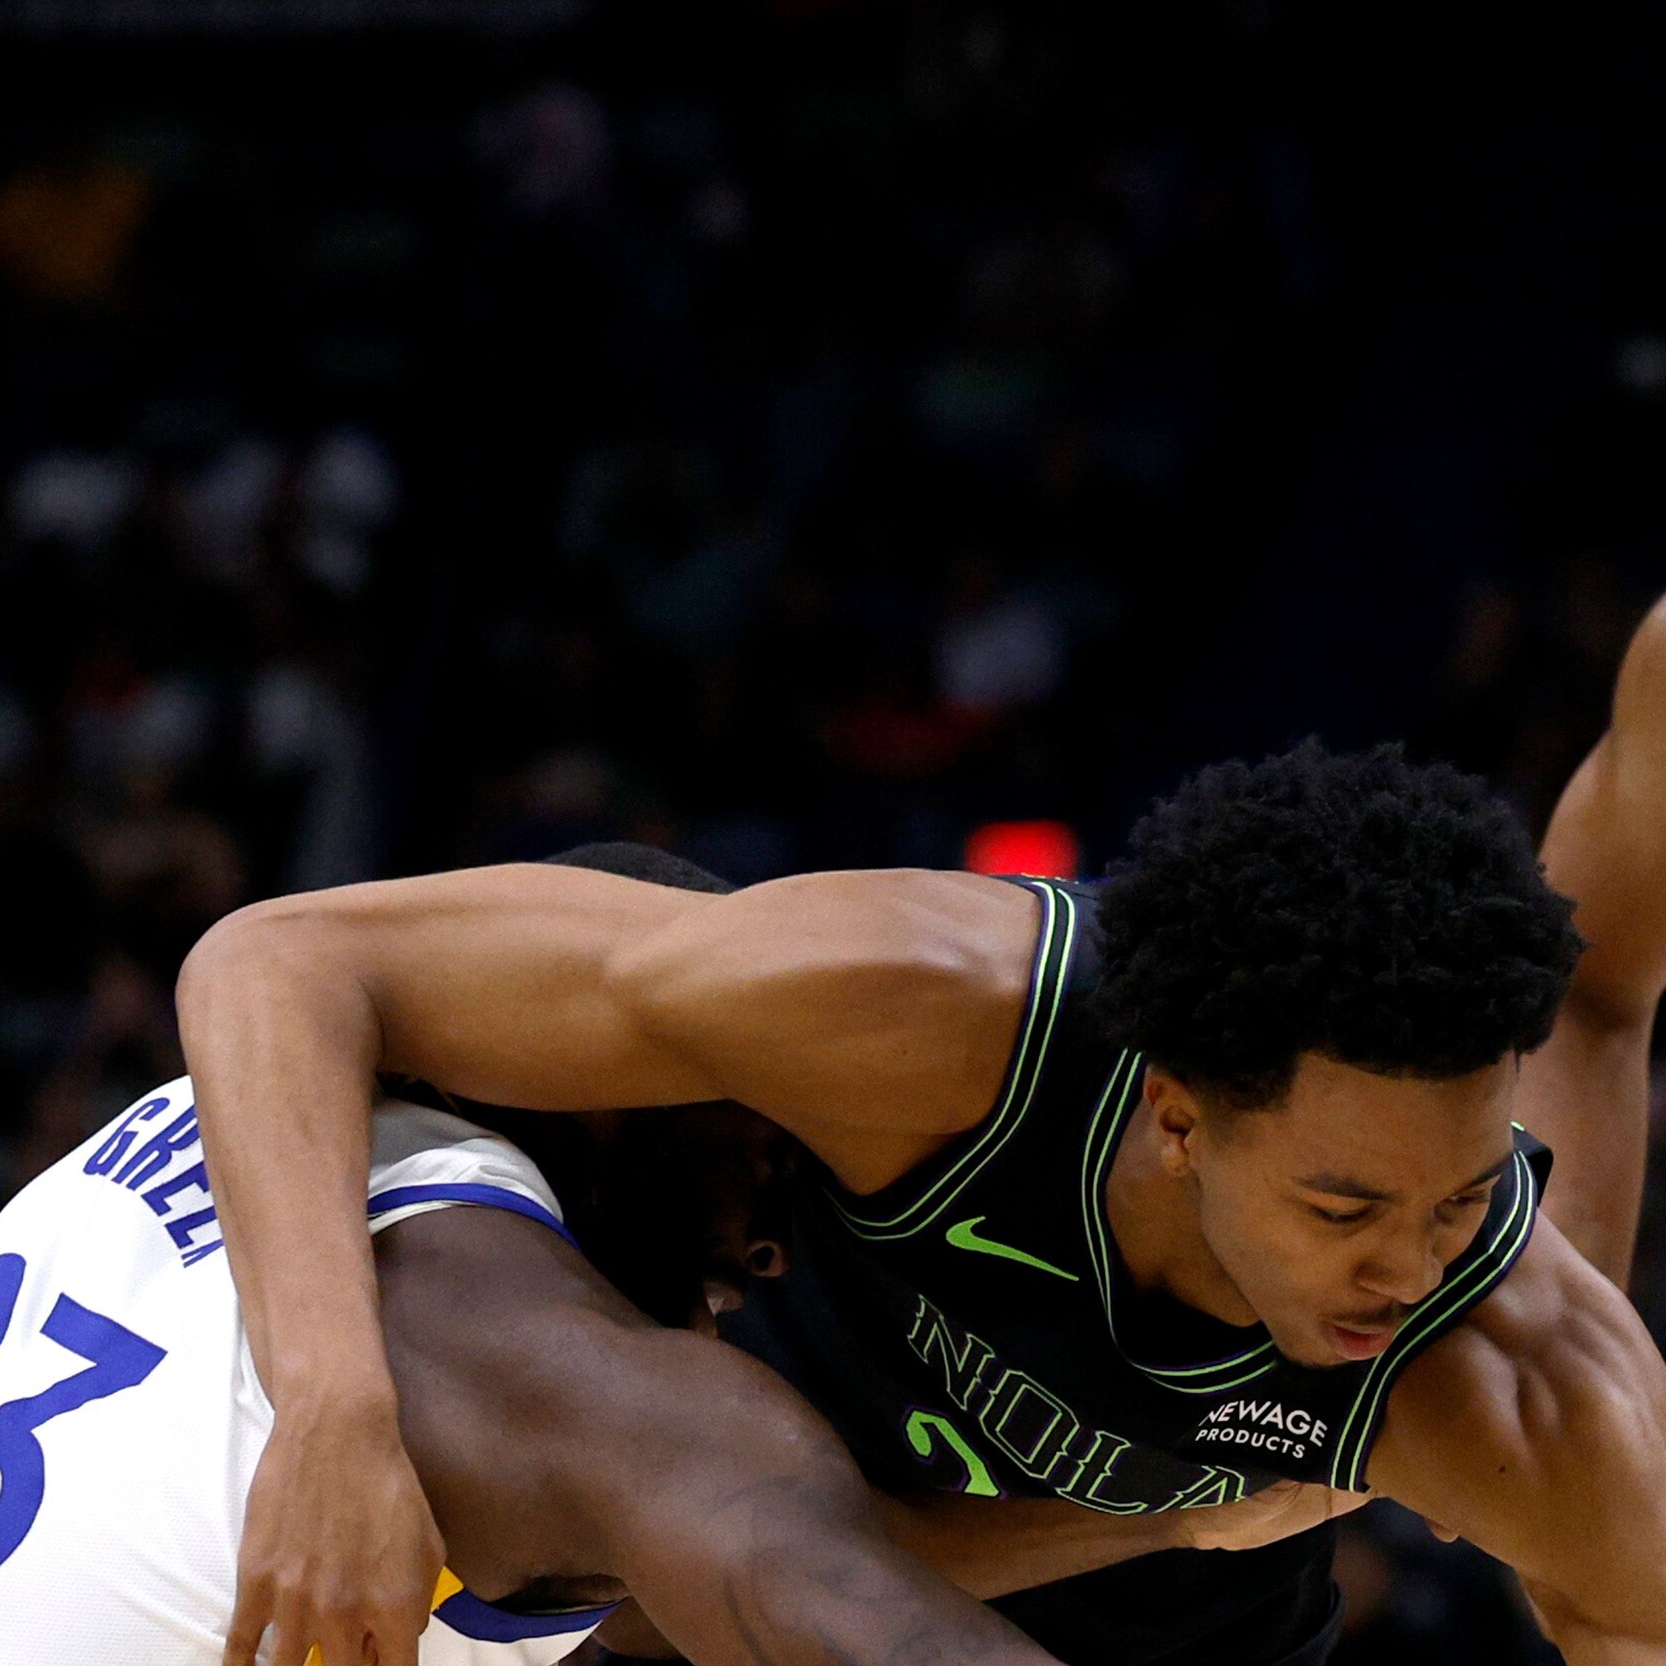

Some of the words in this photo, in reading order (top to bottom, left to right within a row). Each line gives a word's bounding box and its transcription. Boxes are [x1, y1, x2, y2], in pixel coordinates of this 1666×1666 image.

[907, 1293, 1246, 1515] NOLA
[1197, 1399, 1329, 1448] NEWAGE
[1194, 1427, 1306, 1459] PRODUCTS
